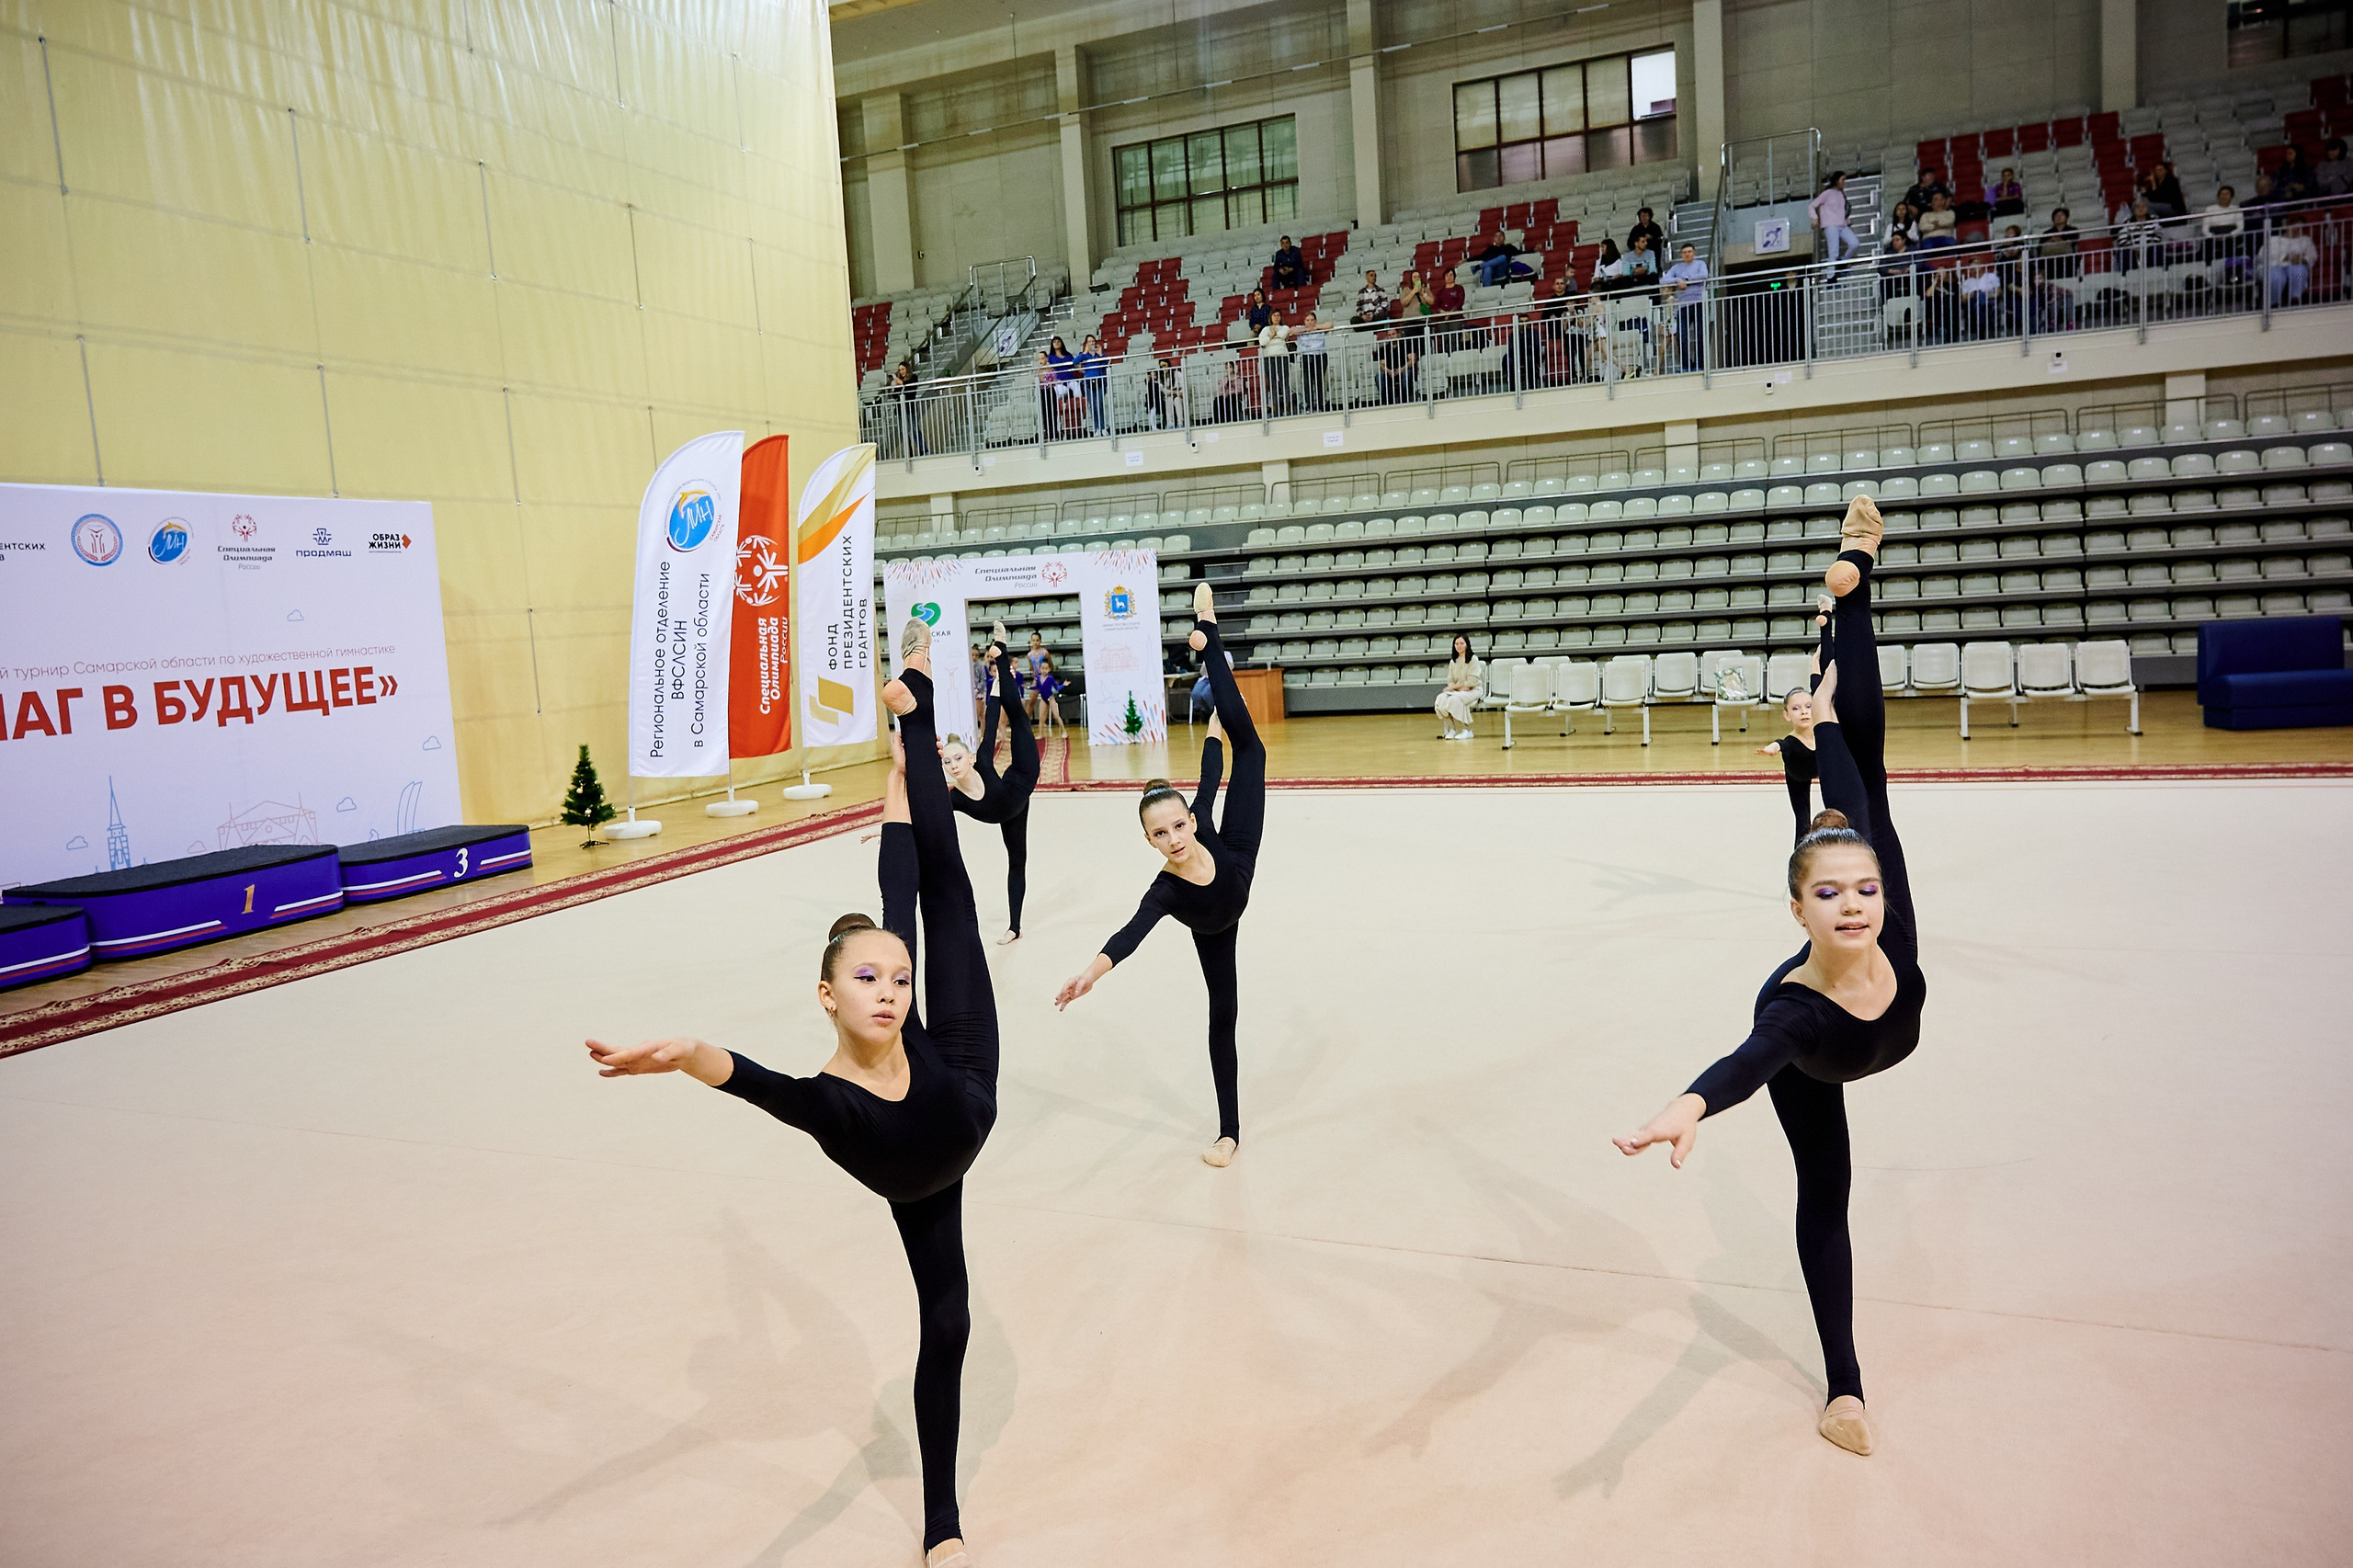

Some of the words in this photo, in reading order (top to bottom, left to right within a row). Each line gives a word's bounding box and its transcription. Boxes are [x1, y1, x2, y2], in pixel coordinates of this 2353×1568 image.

[218, 545, 276, 553] Специальная
[295, 550, 352, 558] ПРОДМАШ
[372, 533, 400, 541] ОБРАЗ
[974, 565, 1037, 574] Специальная
[985, 574, 1038, 582] Олимпиада
[655, 561, 670, 643] отделение
[693, 573, 710, 637] области
[842, 535, 854, 669] ПРЕЗИДЕНТСКИХ
[779, 616, 788, 664] России
[828, 623, 839, 670] ФОНД
[858, 598, 869, 668] ГРАНТОВ
[13, 665, 69, 681] турнир
[74, 659, 157, 675] Самарской
[161, 656, 216, 669] области
[220, 655, 235, 665] по
[239, 648, 333, 666] художественной
[335, 645, 395, 657] гимнастике
[671, 619, 687, 699] ВФСЛСИН
[757, 617, 771, 714] Специальная
[767, 617, 781, 700] Олимпиада
[102, 684, 138, 730] В
[153, 665, 399, 727] БУДУЩЕЕ»
[650, 648, 665, 757] Региональное
[691, 642, 706, 734] Самарской
[694, 739, 704, 747] в
[454, 847, 469, 878] 3
[241, 883, 256, 915] 1
